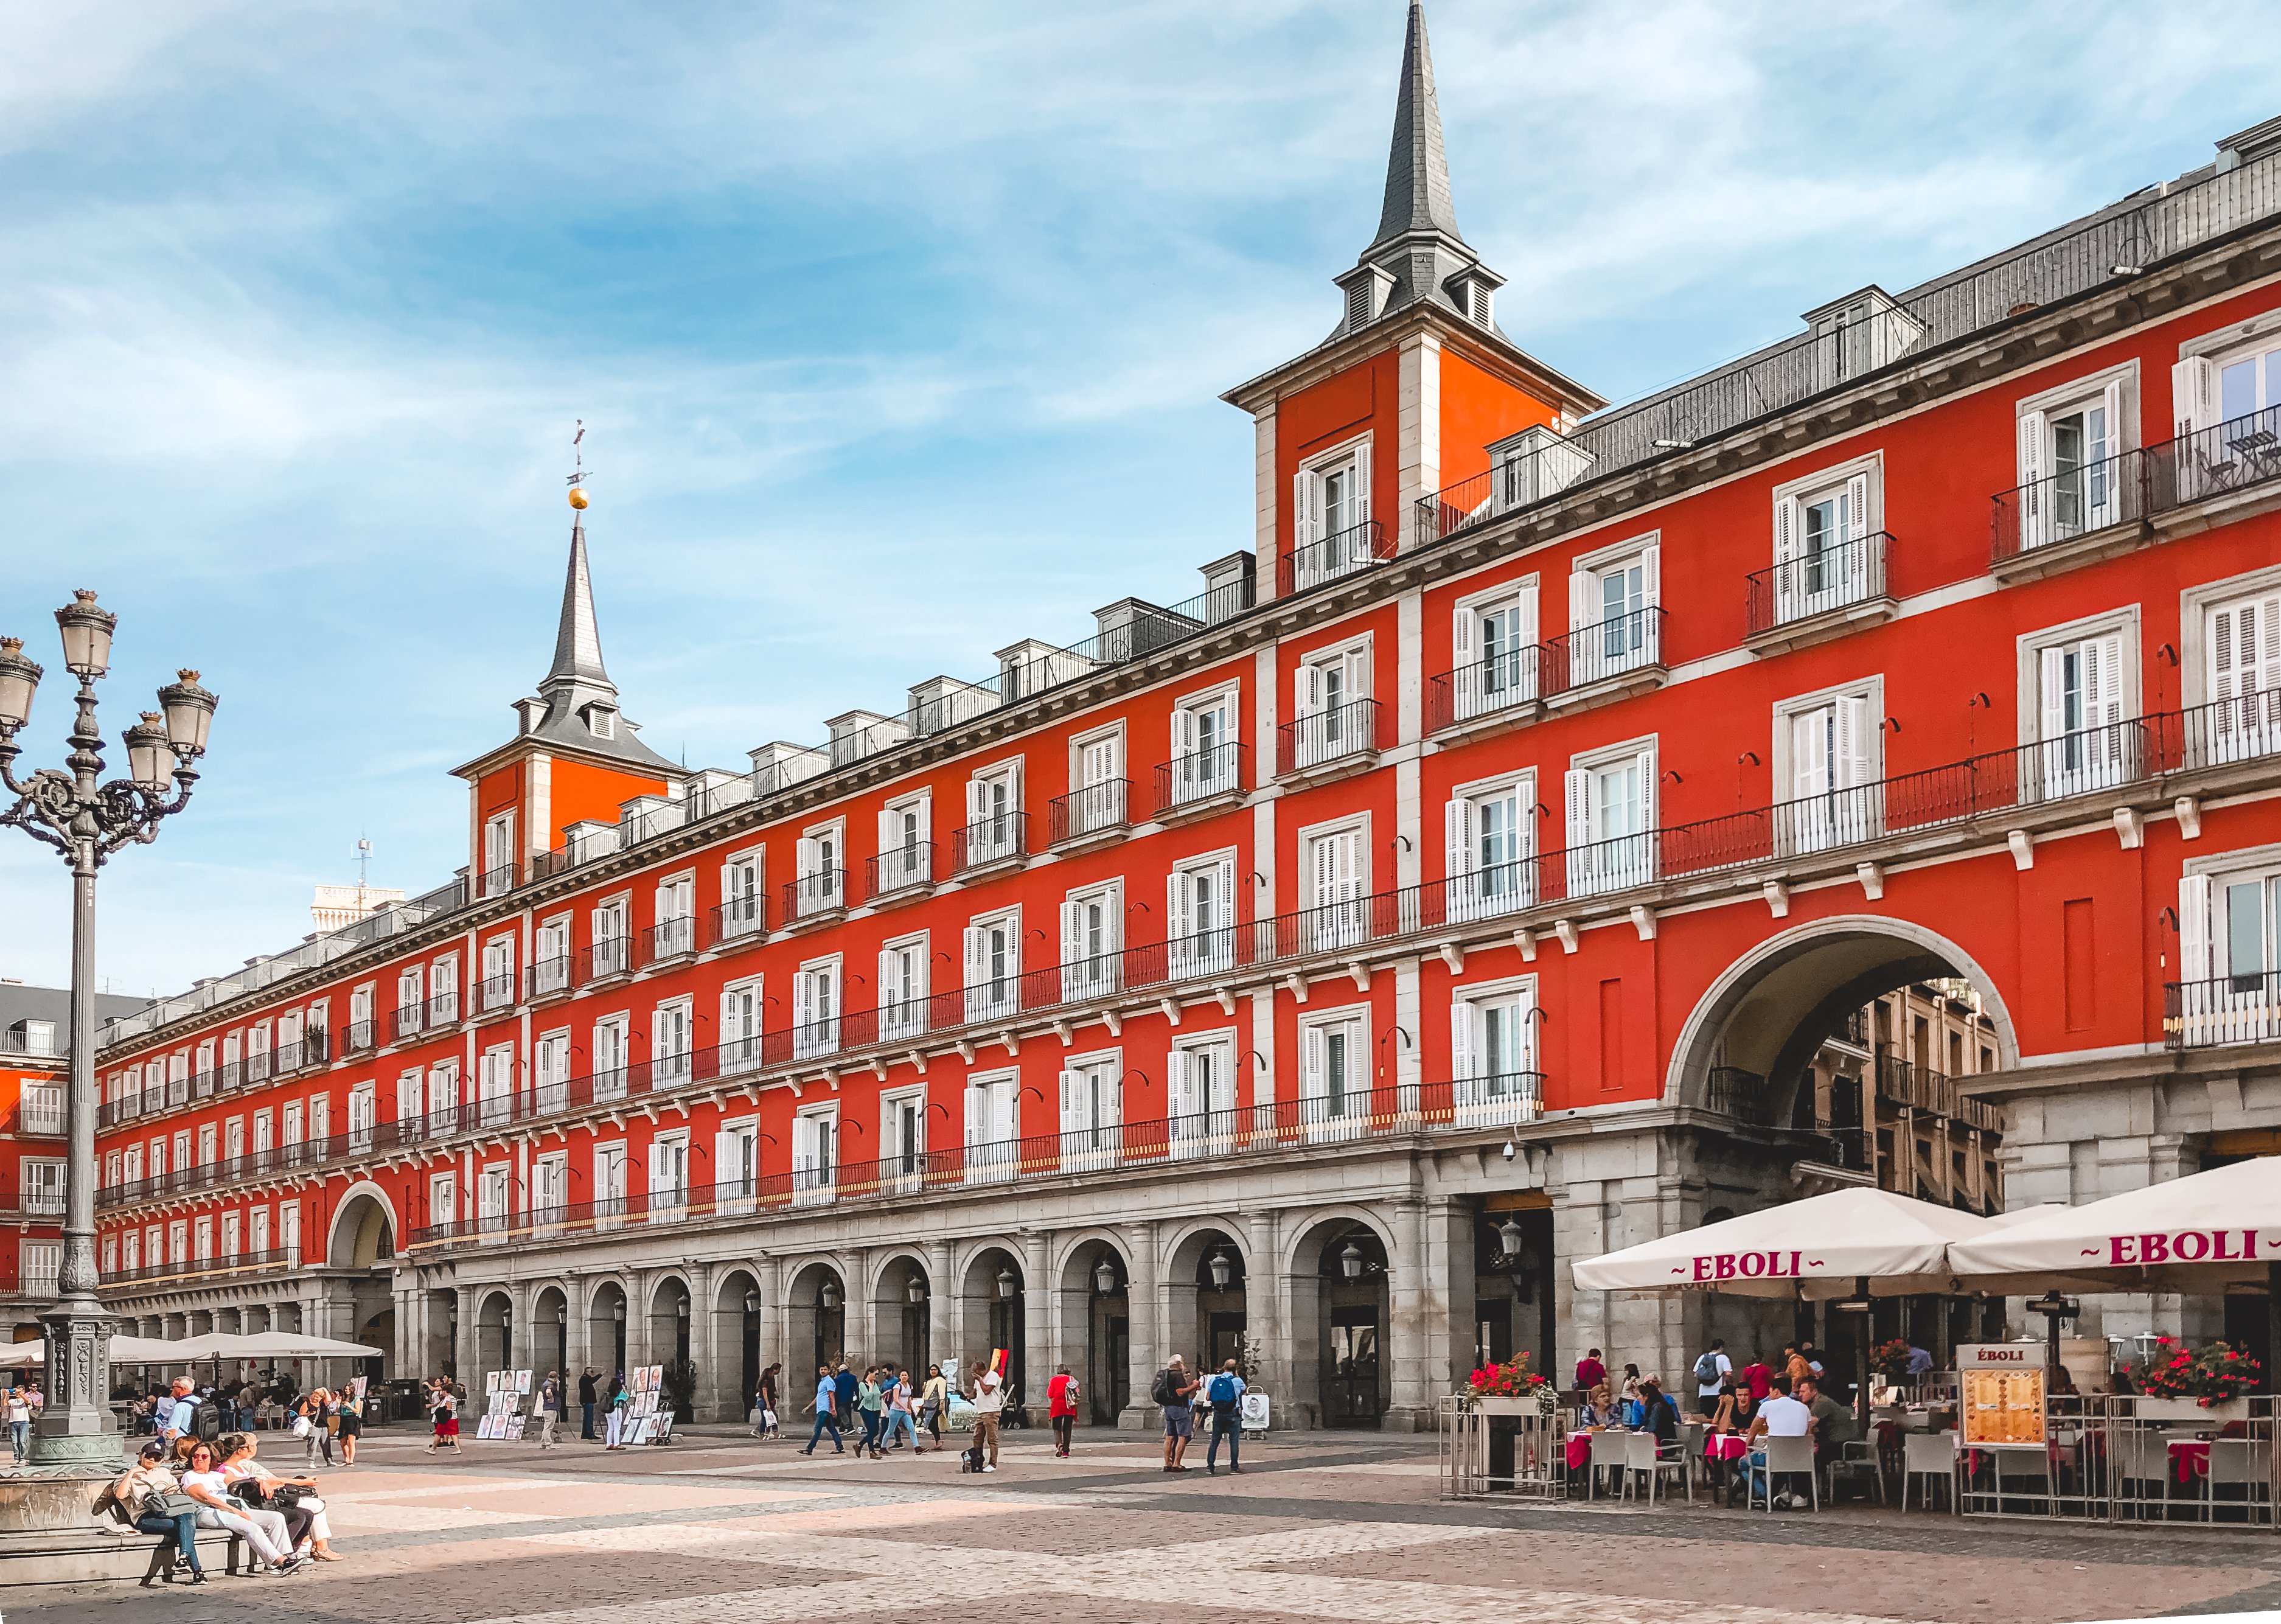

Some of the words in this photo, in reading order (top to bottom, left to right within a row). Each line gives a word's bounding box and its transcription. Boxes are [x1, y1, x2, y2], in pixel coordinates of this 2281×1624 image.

[2110, 1229, 2258, 1267] EBOLI
[1693, 1250, 1802, 1283] EBOLI
[1977, 1348, 2024, 1362] ÉBOLI
